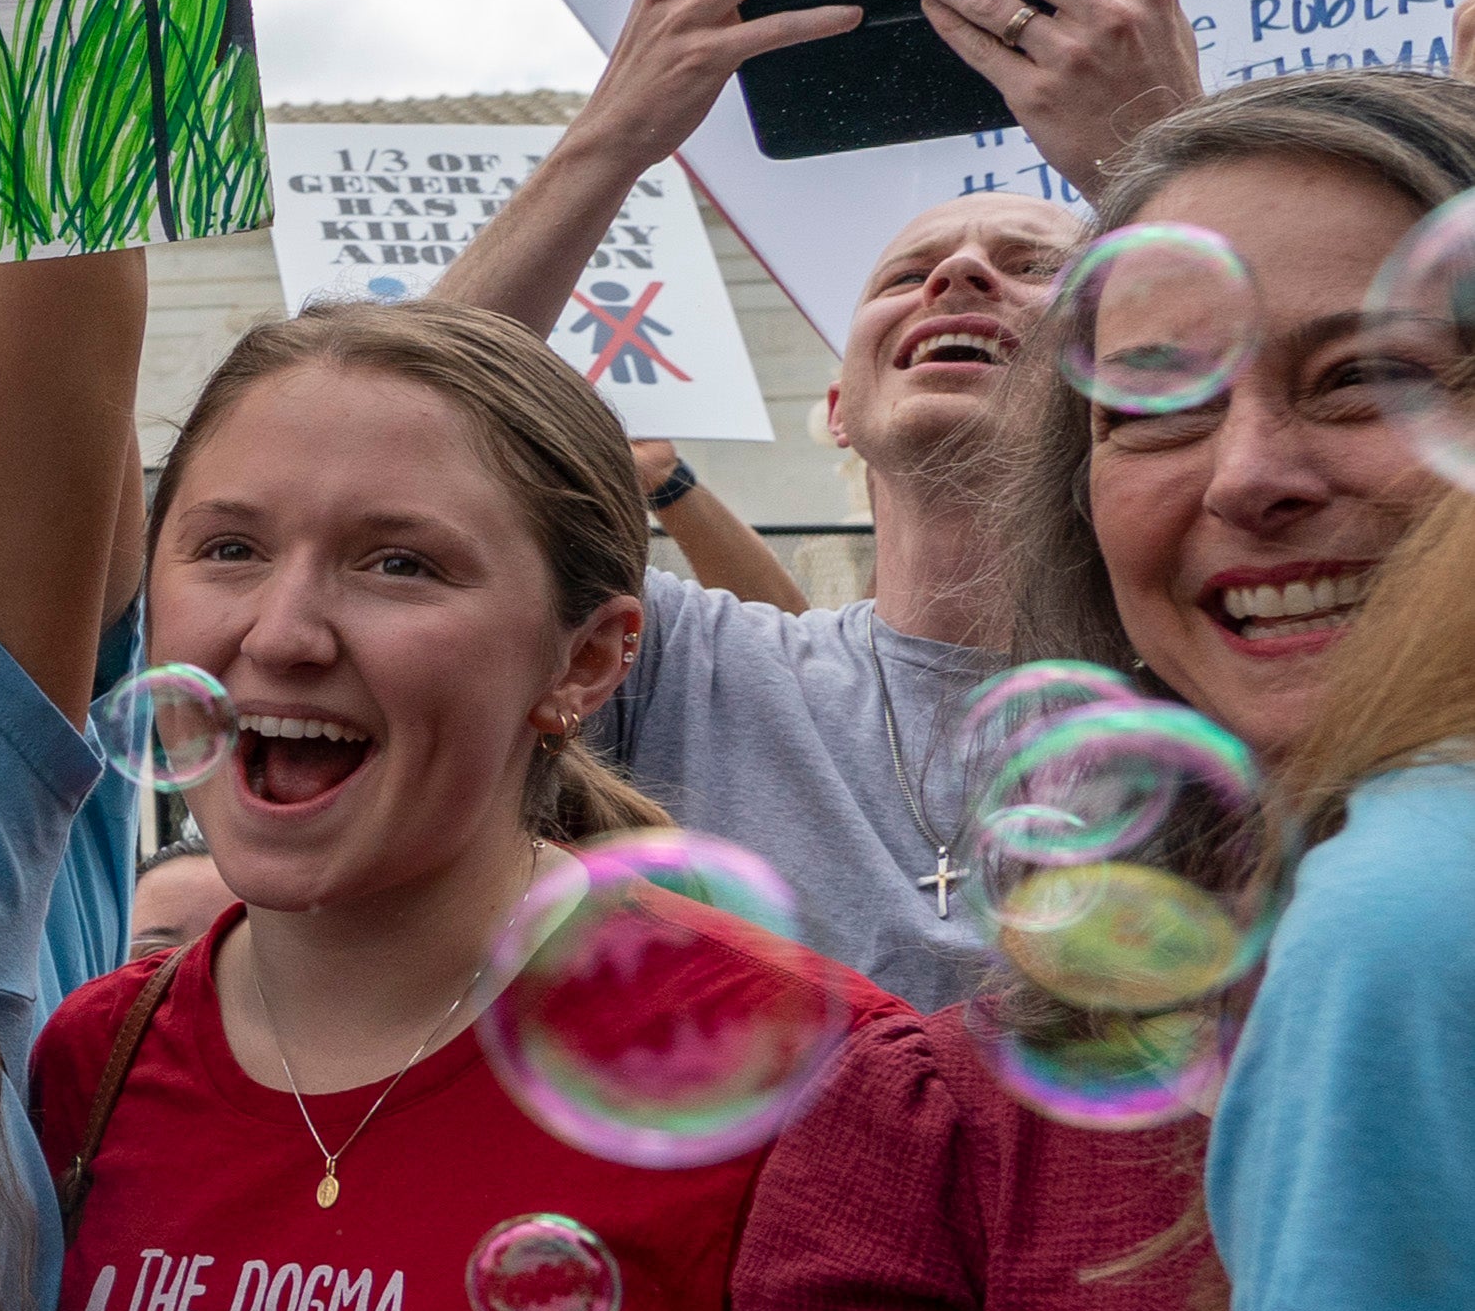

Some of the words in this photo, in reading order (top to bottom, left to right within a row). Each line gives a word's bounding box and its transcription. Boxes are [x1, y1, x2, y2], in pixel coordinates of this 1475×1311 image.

[337, 148, 409, 173] 1/3
[427, 153, 501, 173] OF
[337, 198, 458, 217] HAS
